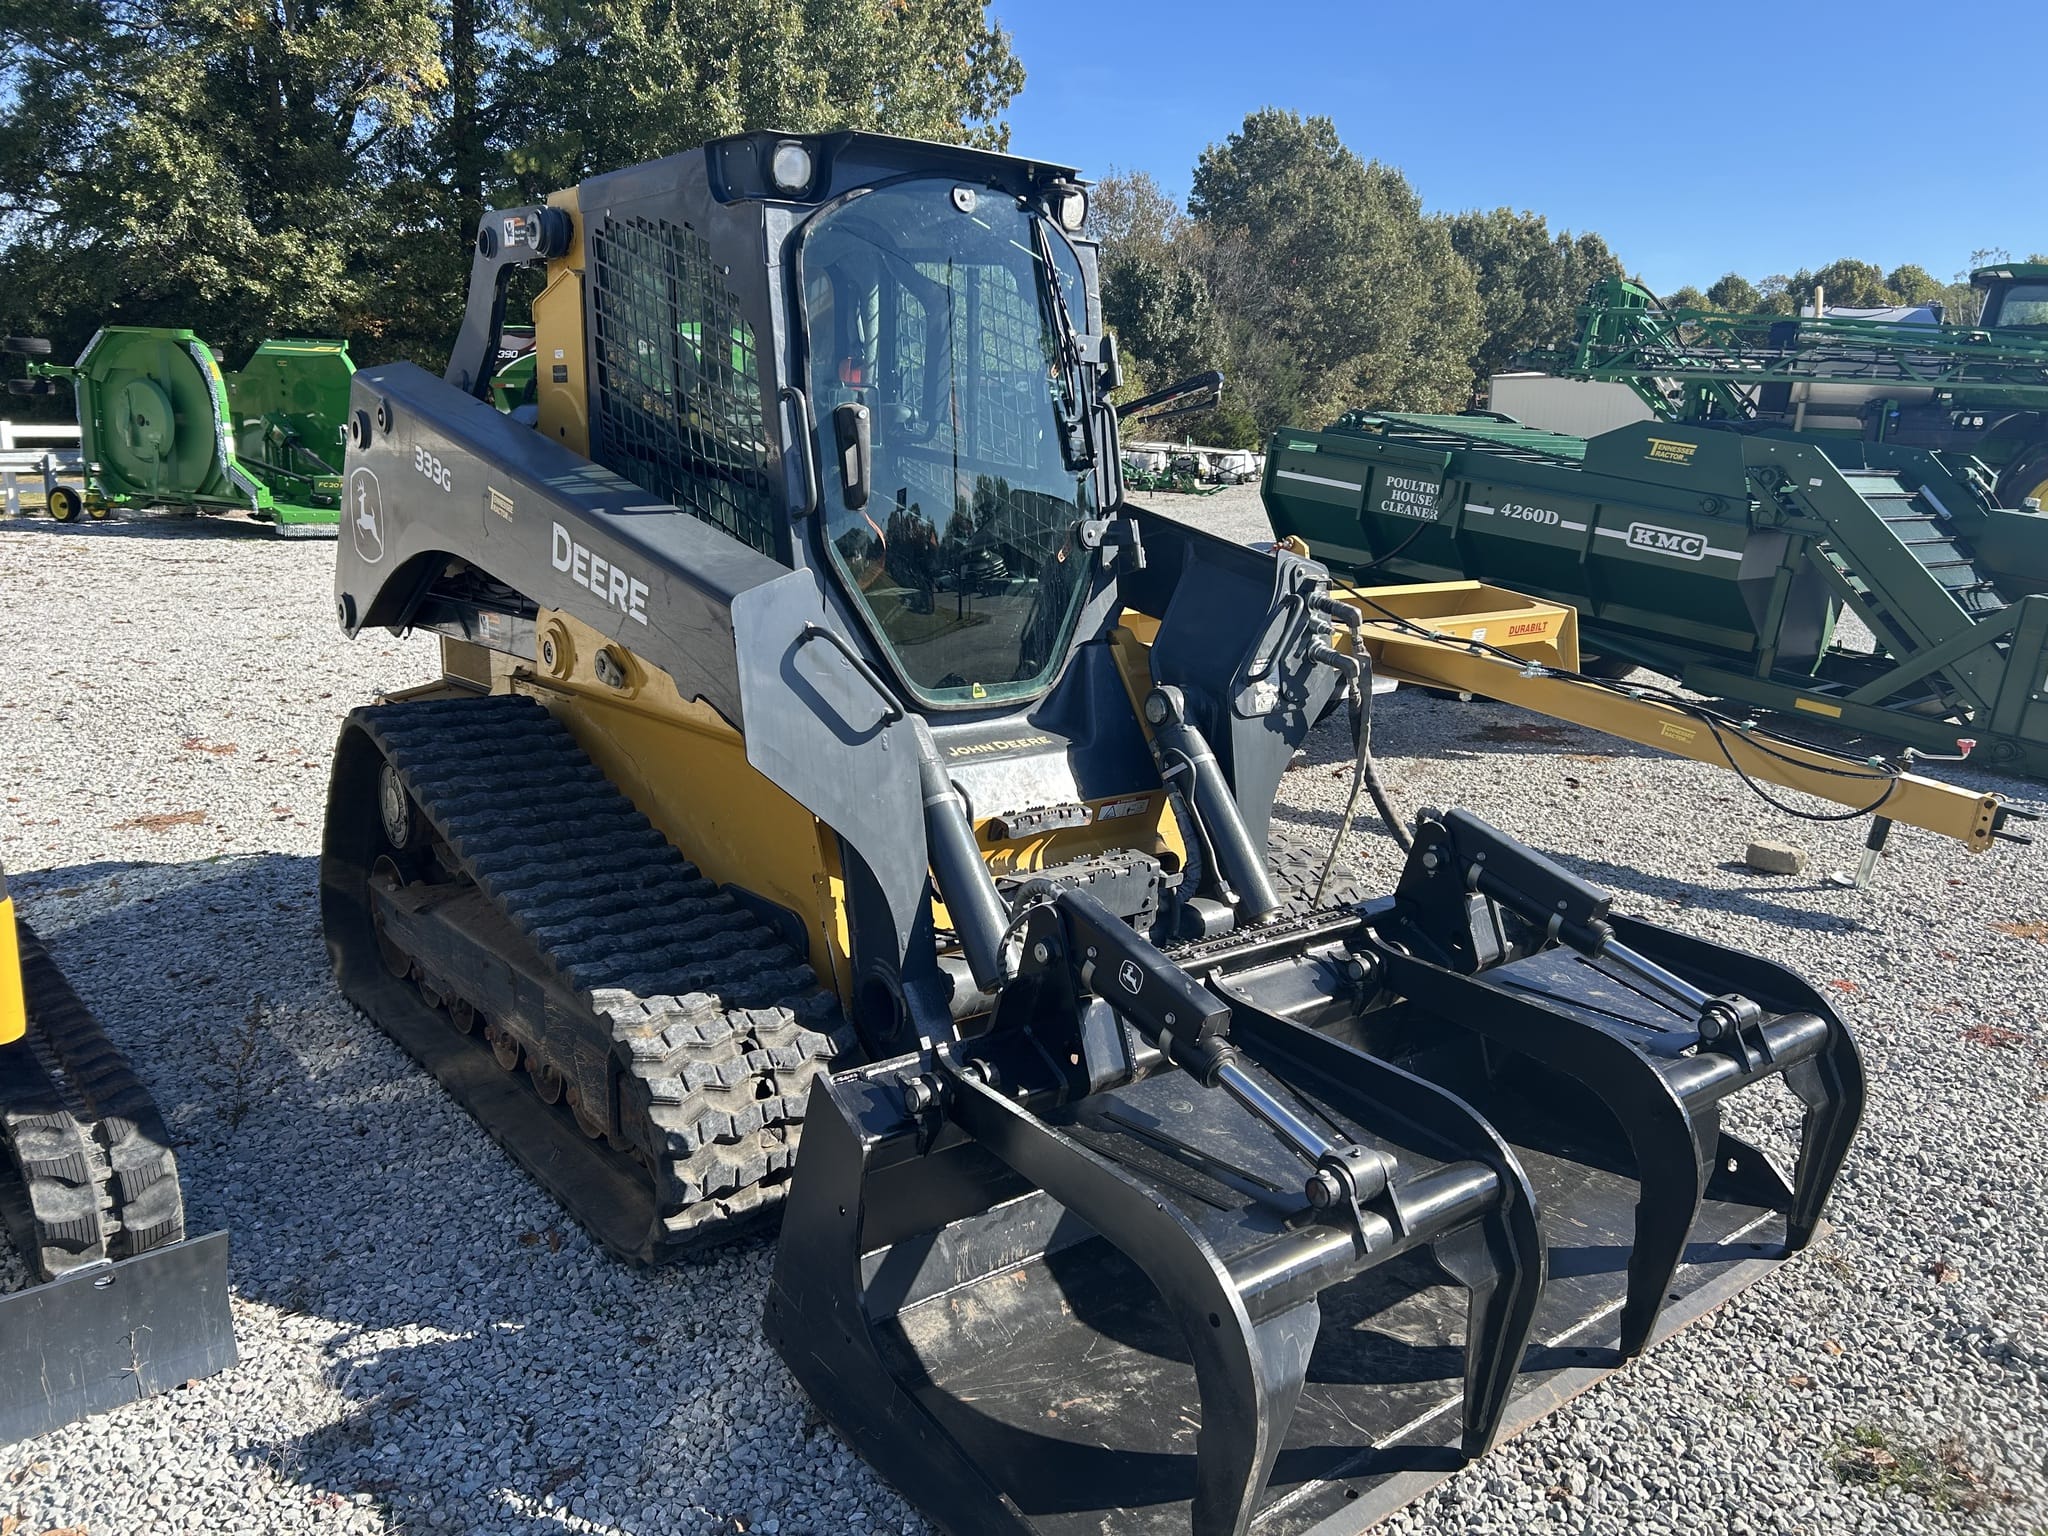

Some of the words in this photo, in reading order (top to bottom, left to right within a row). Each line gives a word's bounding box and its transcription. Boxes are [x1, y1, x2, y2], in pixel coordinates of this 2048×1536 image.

[497, 350, 518, 359] 390
[415, 445, 451, 492] 333G
[1386, 475, 1440, 495] POULTRY
[1391, 489, 1433, 507] HOUSE
[1381, 500, 1438, 521] CLEANER
[1500, 503, 1559, 525] 4260D
[1633, 527, 1700, 554] KMC
[552, 521, 649, 626] DEERE
[1509, 622, 1548, 635] DURABILT
[949, 743, 995, 757] JOHN
[994, 736, 1052, 750] DEERE
